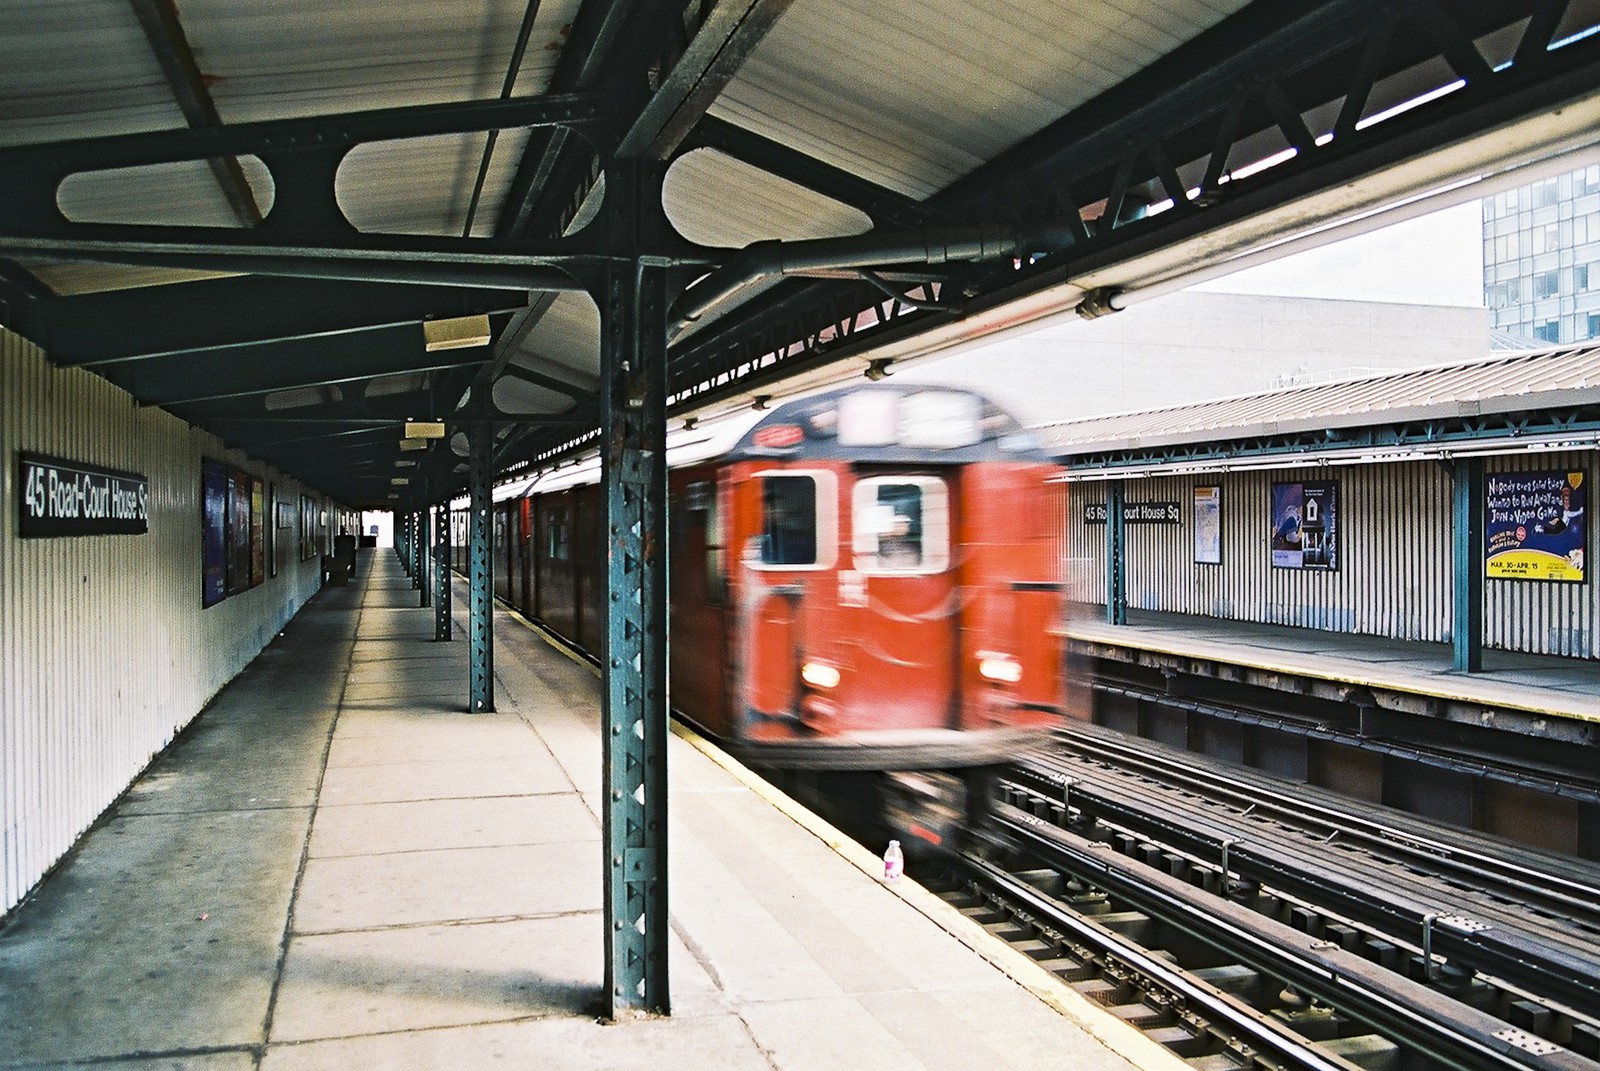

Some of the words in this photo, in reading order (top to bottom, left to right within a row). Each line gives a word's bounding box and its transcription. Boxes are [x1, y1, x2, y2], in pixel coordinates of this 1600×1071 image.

[26, 466, 45, 517] 45
[49, 469, 109, 518] Road-Court
[112, 480, 137, 519] House
[1085, 507, 1095, 519] 45
[1141, 505, 1166, 520] House
[1167, 504, 1179, 522] Sq
